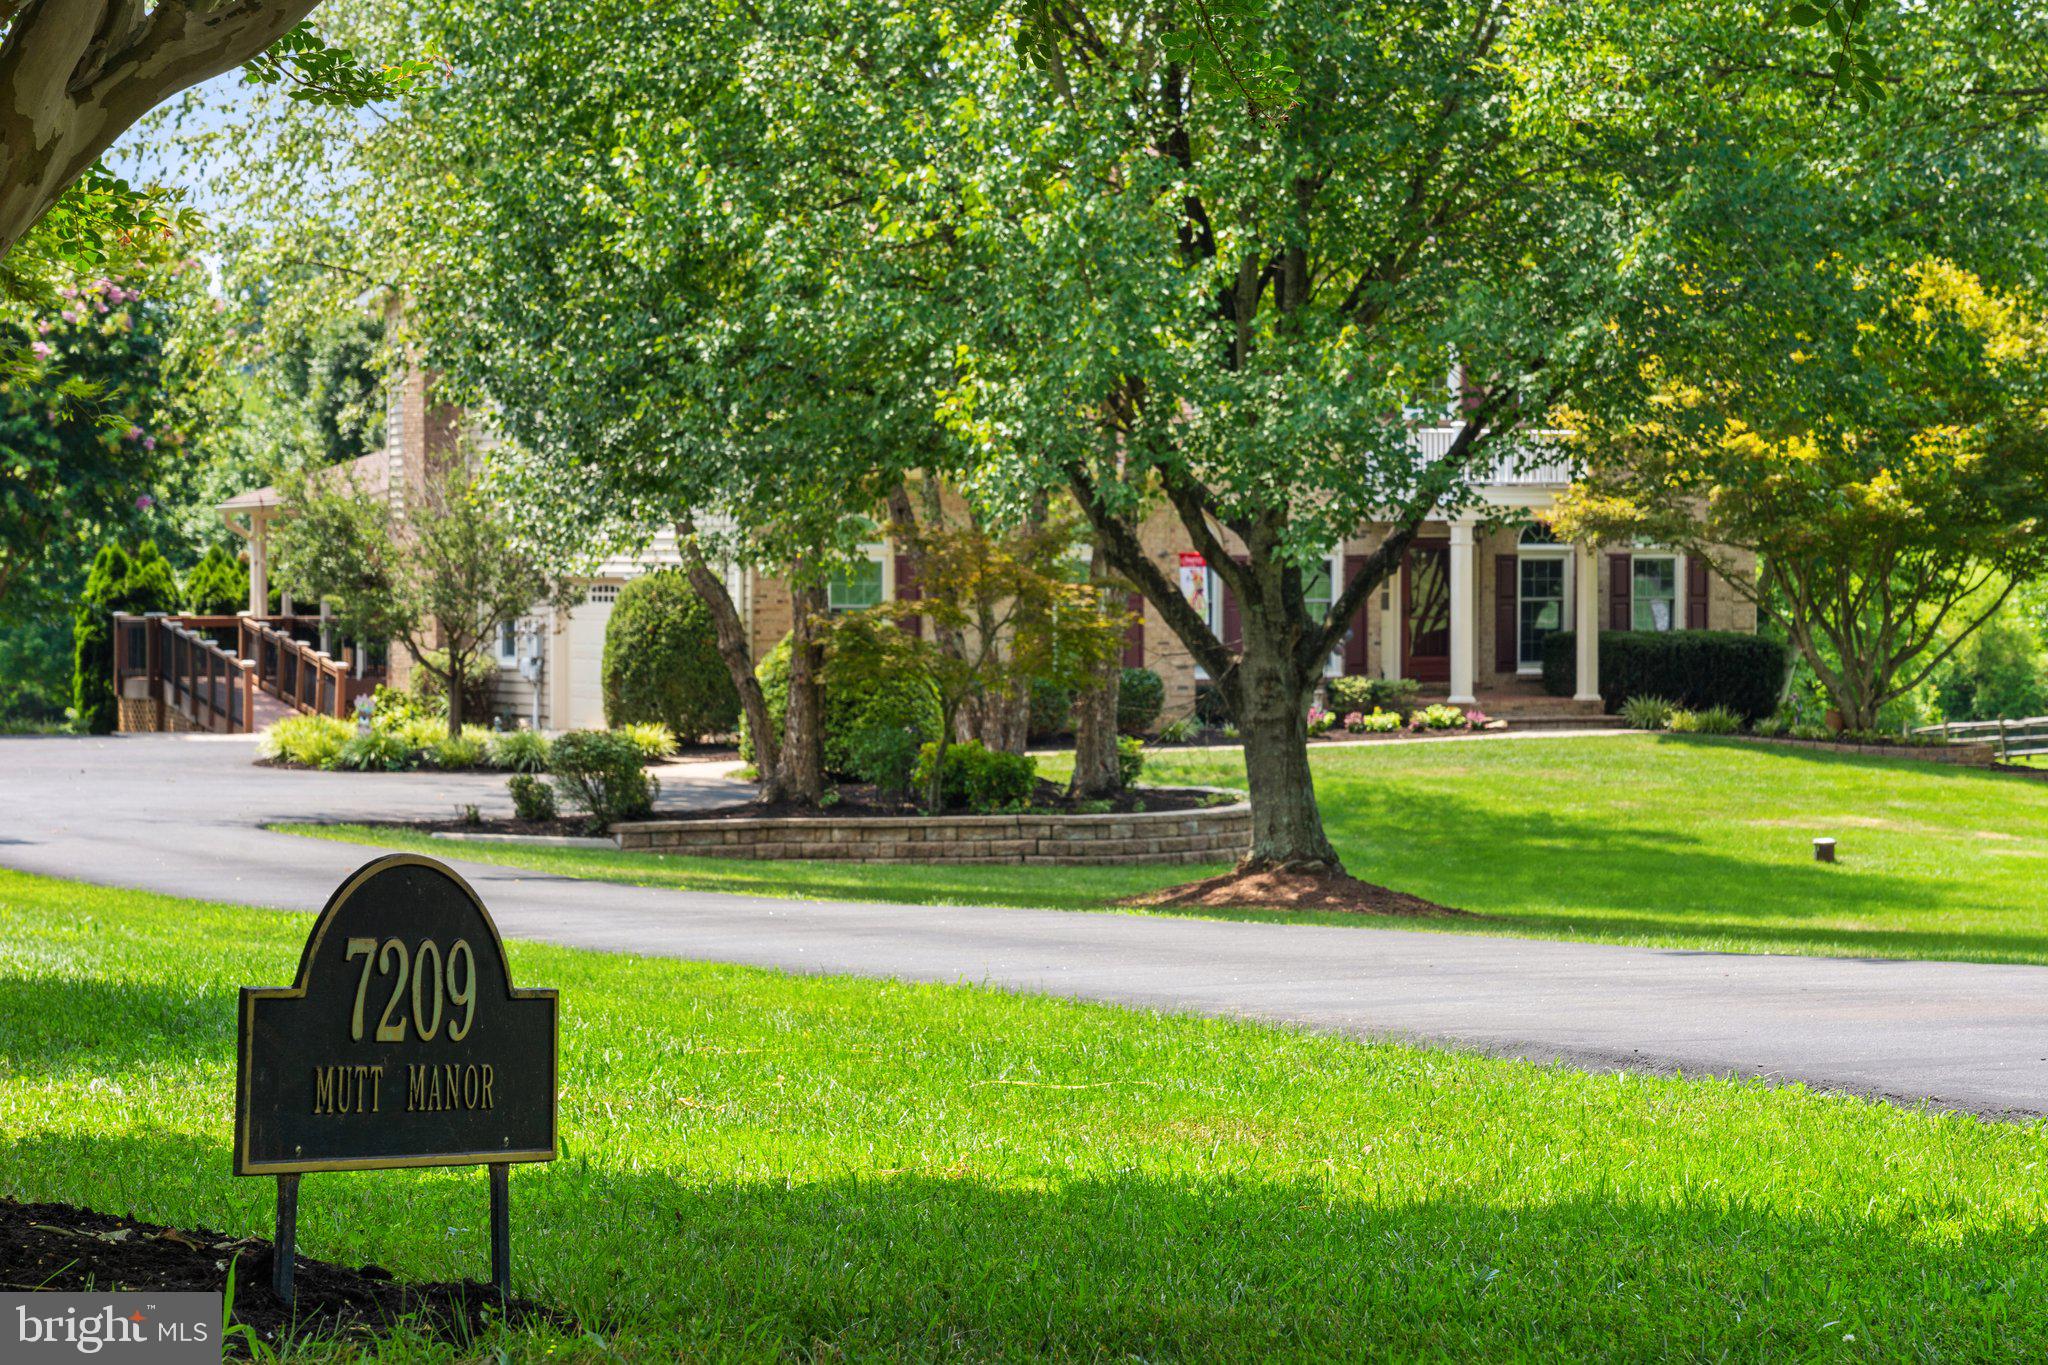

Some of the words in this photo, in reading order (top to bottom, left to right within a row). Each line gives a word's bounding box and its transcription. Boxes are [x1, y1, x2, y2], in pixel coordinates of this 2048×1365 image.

[345, 937, 477, 1042] 7209
[313, 1065, 384, 1114] MUTT
[406, 1063, 495, 1112] MANOR
